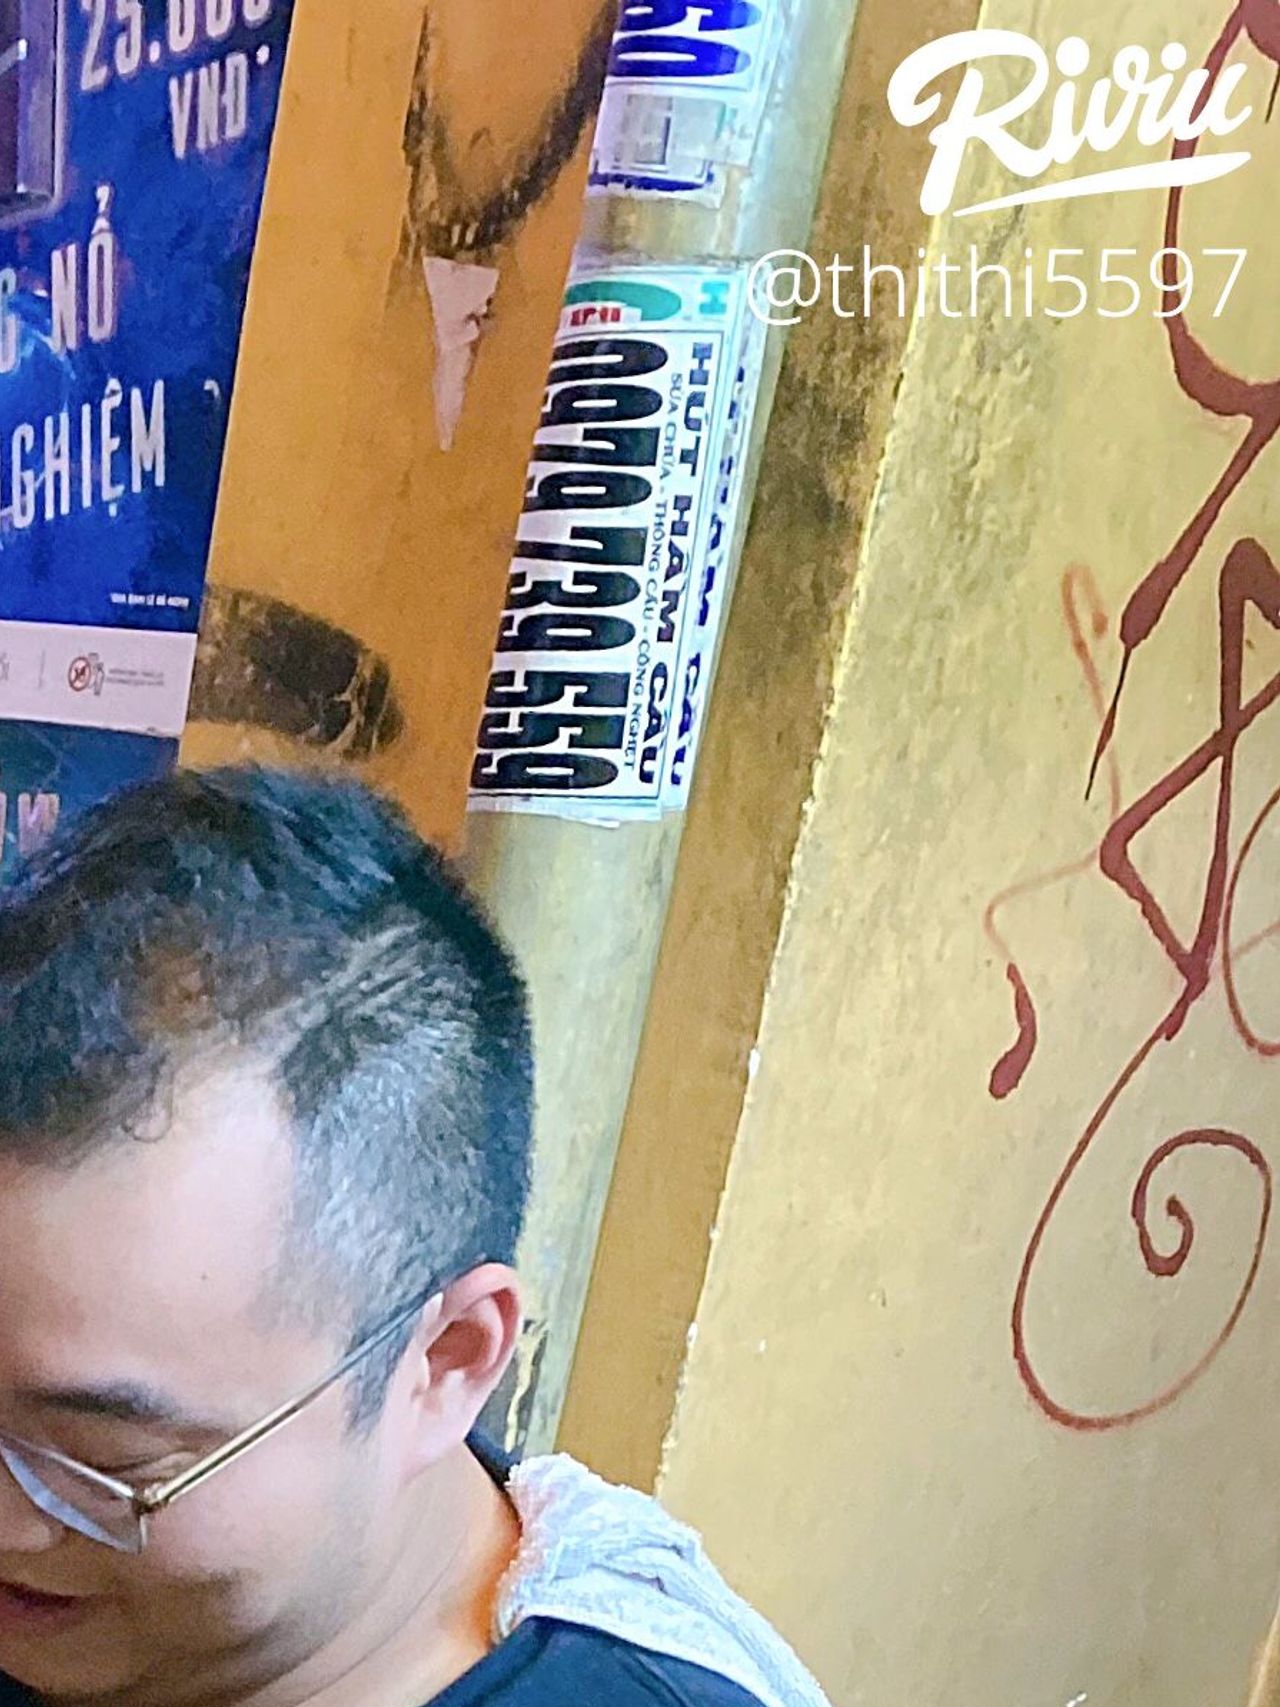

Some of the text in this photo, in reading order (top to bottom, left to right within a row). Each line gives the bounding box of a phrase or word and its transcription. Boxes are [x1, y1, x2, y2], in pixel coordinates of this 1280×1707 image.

[81, 0, 271, 91] 25.0
[169, 52, 248, 160] VNĐ
[50, 185, 117, 354] NỔ
